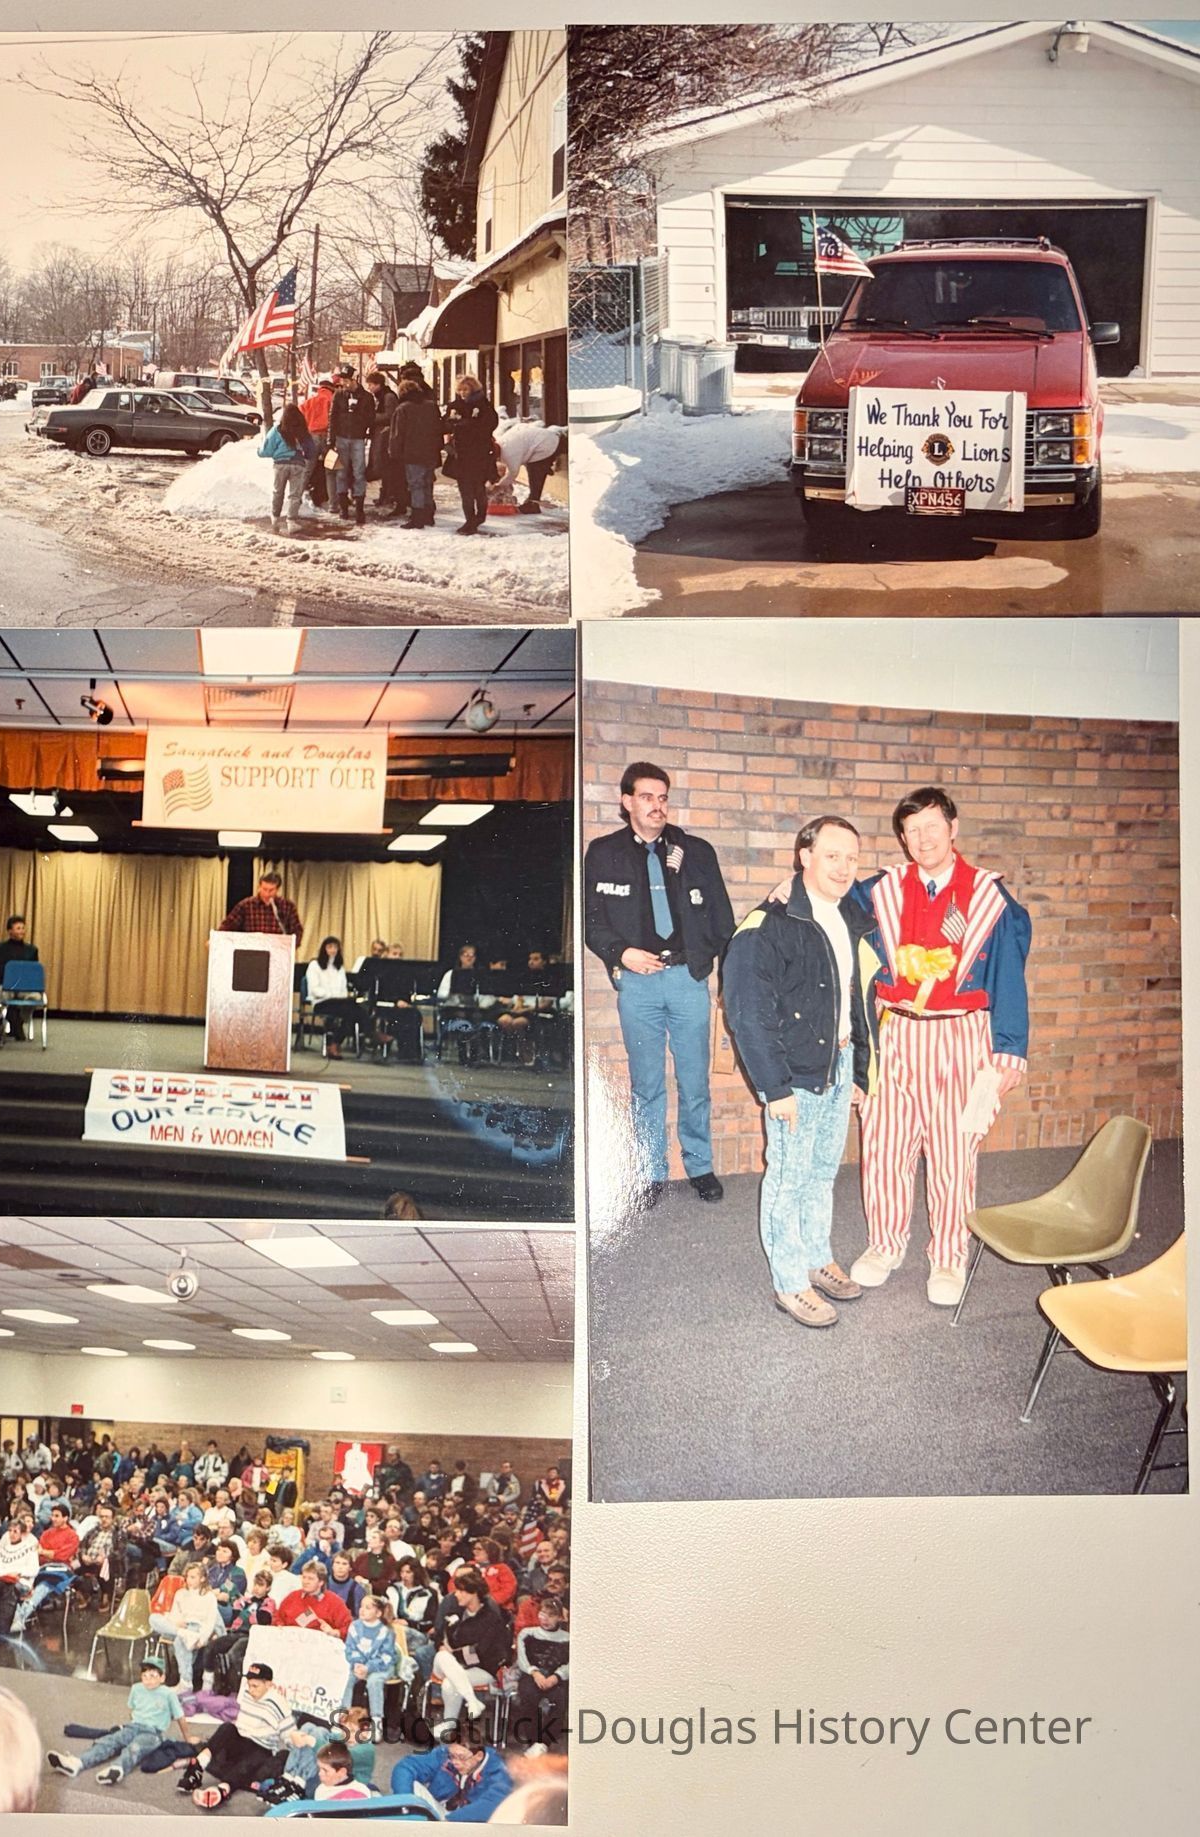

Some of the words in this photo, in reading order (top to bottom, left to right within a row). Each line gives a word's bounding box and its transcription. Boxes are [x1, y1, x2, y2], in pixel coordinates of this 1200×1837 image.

[820, 243, 835, 256] 76
[867, 398, 887, 425] We
[892, 403, 940, 427] Thank
[945, 401, 973, 428] You
[979, 409, 1009, 430] For
[857, 436, 913, 464] Helping
[961, 440, 1011, 463] Lions
[933, 442, 943, 456] L
[933, 471, 995, 494] Others
[911, 492, 961, 506] XPN456
[163, 742, 251, 763] Saugatuck
[260, 746, 296, 760] and
[303, 744, 372, 764] Douglas
[220, 765, 319, 789] SUPPORT
[329, 766, 376, 790] OUR
[596, 882, 630, 896] POLICE
[108, 1075, 319, 1110] SUPPORT
[112, 1106, 174, 1132] OUR
[150, 1125, 184, 1143] MEN
[191, 1127, 203, 1143] &
[210, 1128, 274, 1148] WOMEN
